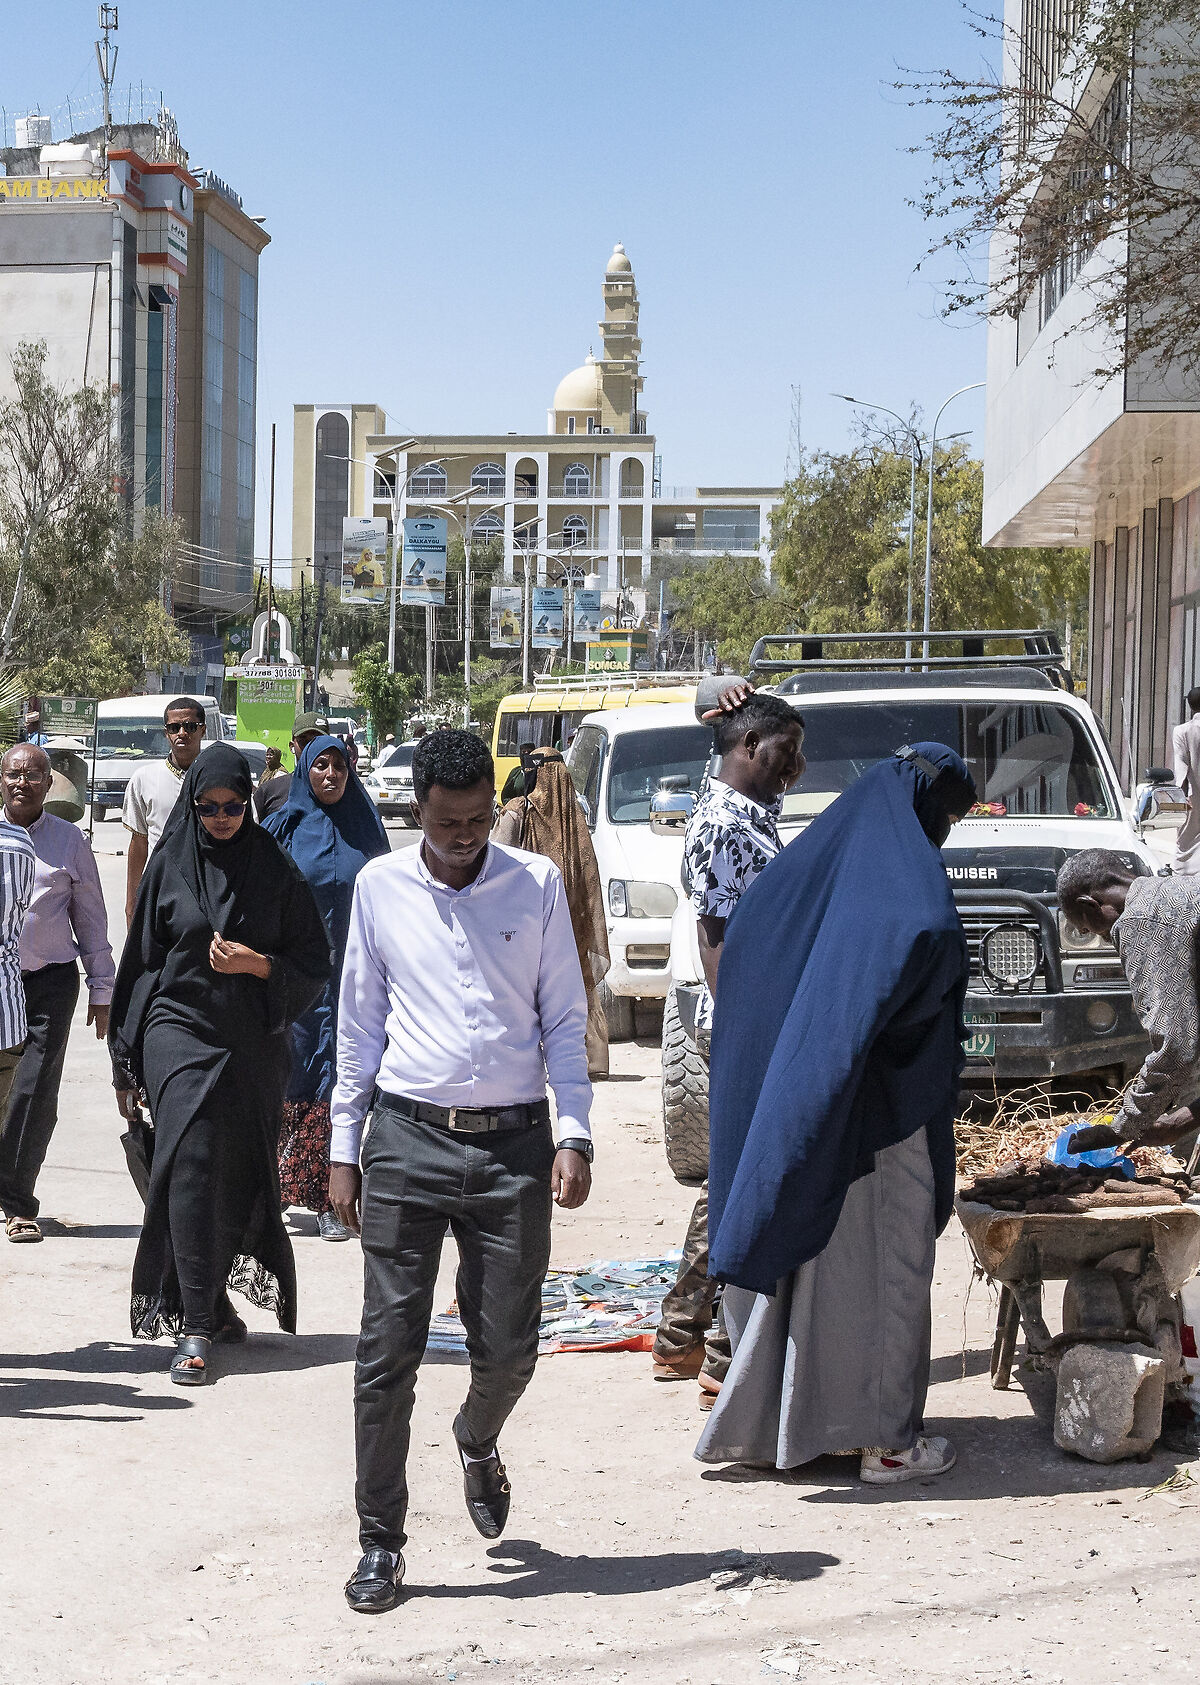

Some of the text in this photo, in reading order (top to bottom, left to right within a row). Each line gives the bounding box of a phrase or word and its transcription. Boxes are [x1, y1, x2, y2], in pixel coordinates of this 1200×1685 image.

[38, 180, 108, 198] BANK
[588, 660, 630, 670] SOMGAS
[275, 669, 301, 678] 301801
[946, 868, 998, 879] RUISER
